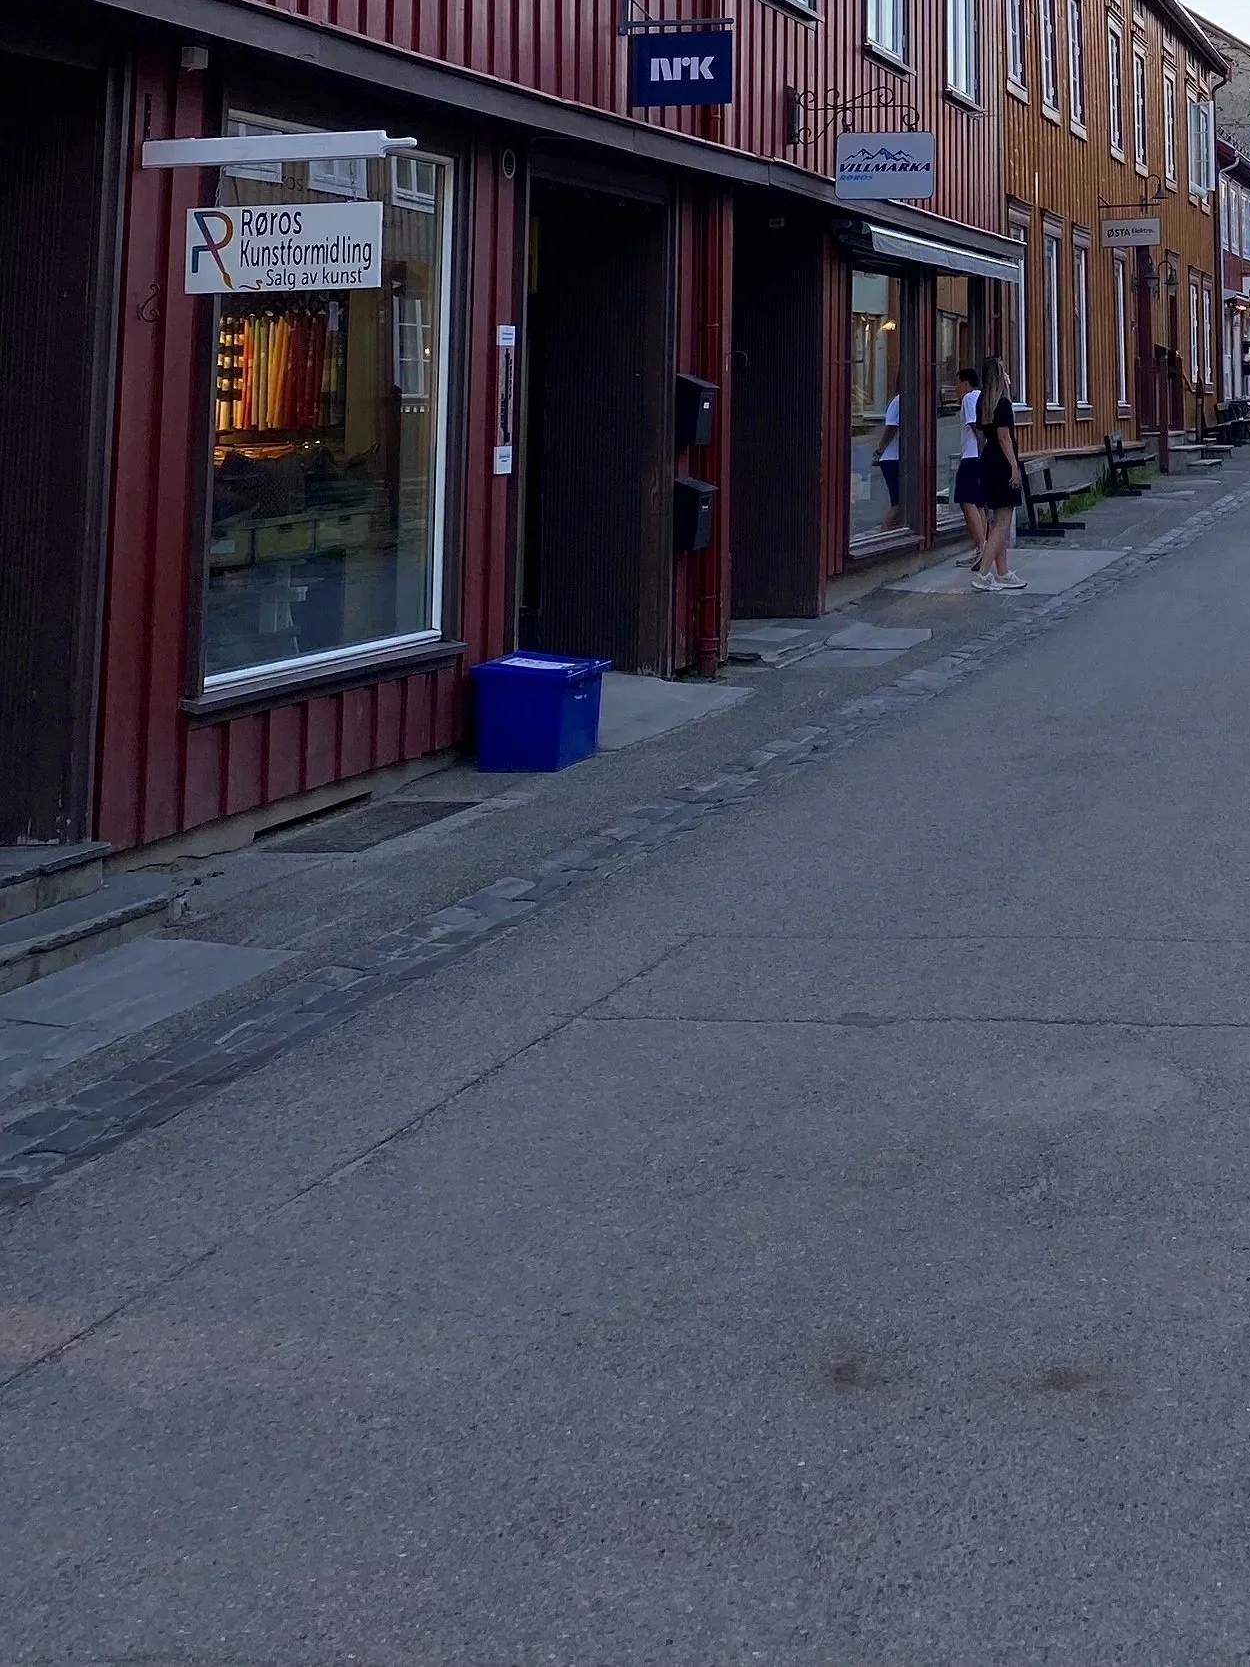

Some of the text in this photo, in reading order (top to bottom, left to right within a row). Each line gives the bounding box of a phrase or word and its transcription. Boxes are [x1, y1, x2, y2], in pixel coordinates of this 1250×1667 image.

[650, 56, 715, 81] NRK
[839, 162, 931, 173] VILLMARKA
[241, 209, 302, 237] Røros
[1107, 228, 1131, 238] ØSTA
[240, 236, 372, 271] Kunstformidling
[265, 267, 363, 290] Salg av kunst
